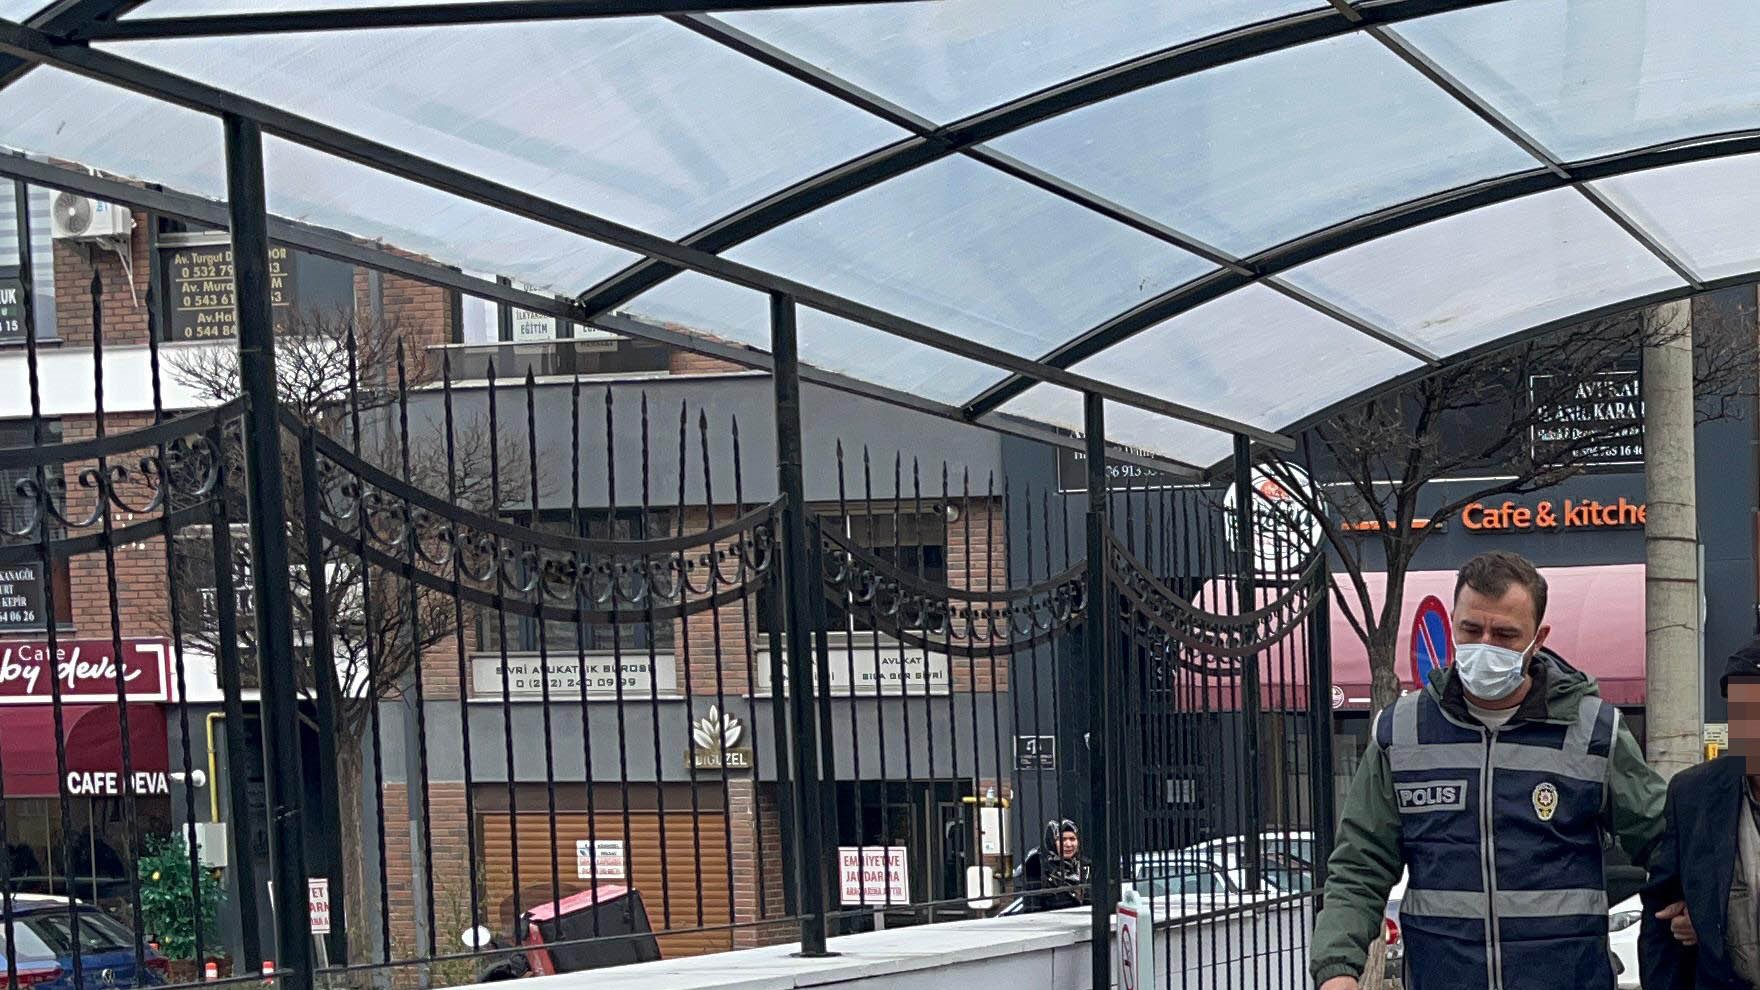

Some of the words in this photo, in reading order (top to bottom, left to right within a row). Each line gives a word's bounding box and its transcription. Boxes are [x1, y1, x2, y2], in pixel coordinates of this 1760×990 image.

[193, 265, 216, 277] 532
[196, 325, 219, 337] 544
[1461, 501, 1531, 529] Cafe
[1535, 500, 1559, 528] &
[1564, 496, 1647, 527] kitche
[66, 771, 118, 795] CAFE
